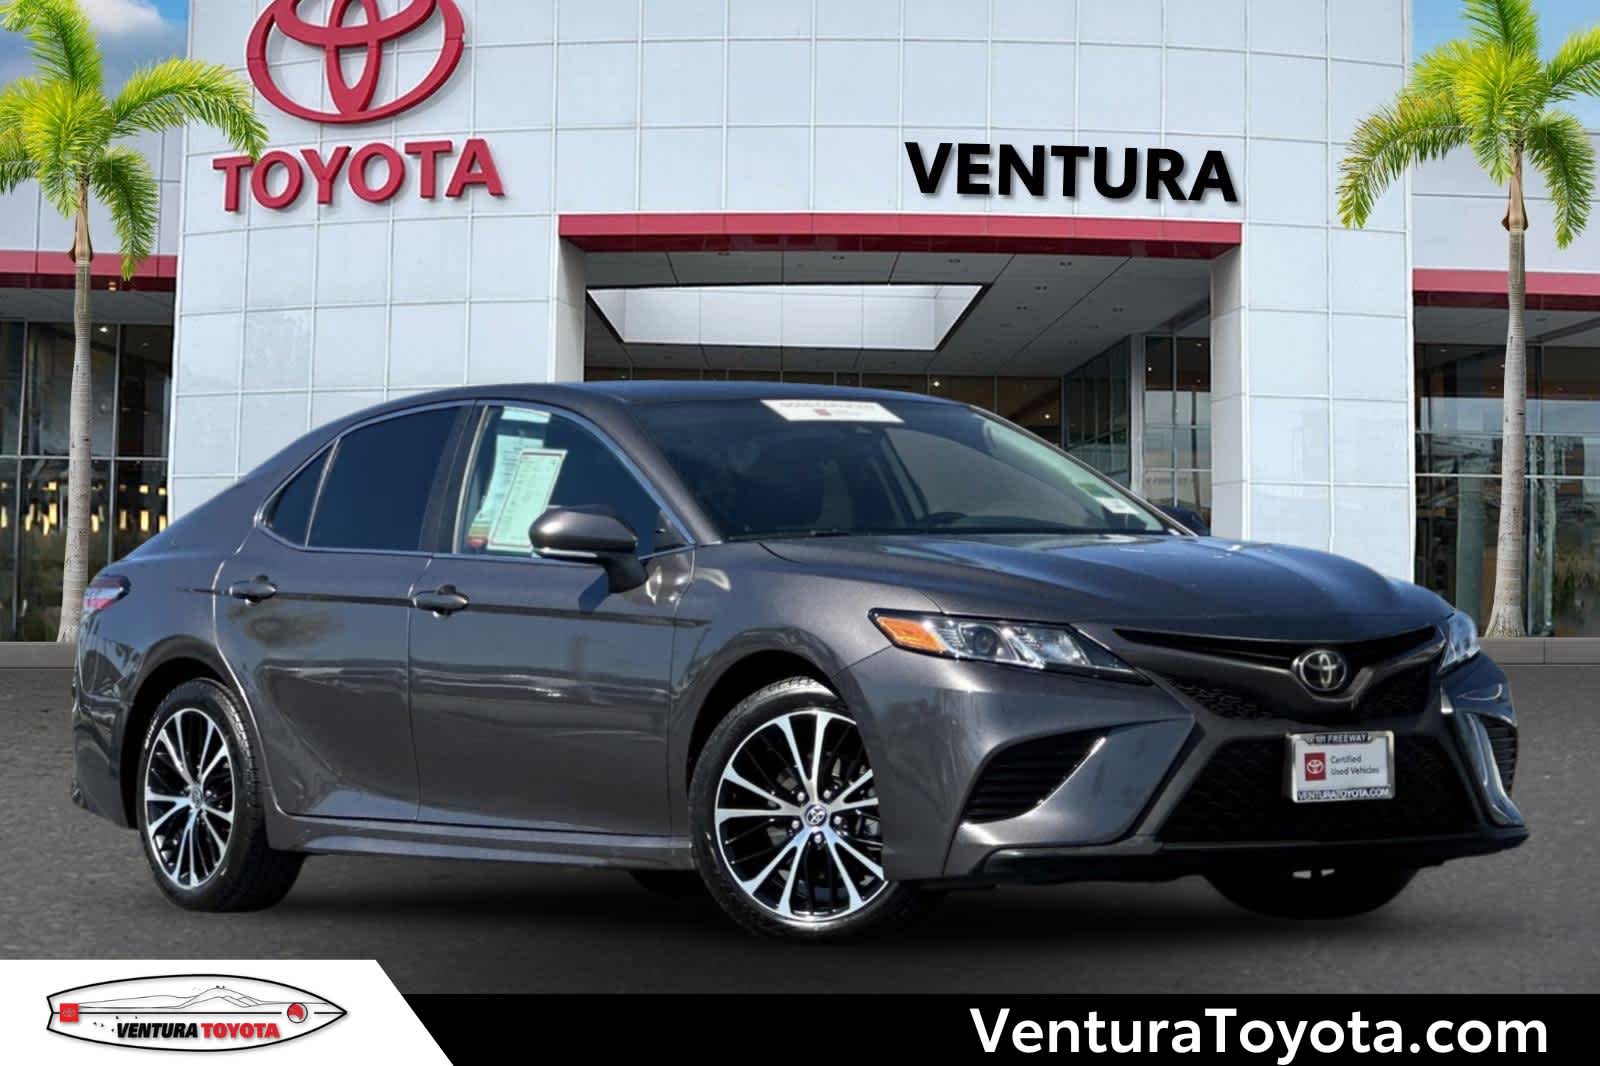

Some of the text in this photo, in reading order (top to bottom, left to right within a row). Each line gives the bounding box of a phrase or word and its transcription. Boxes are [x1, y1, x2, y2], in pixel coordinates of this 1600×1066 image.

[212, 138, 505, 212] TOYOTA
[904, 141, 1239, 203] VENTURA
[1330, 755, 1362, 764] Certified
[1330, 766, 1379, 776] Used Vehicles
